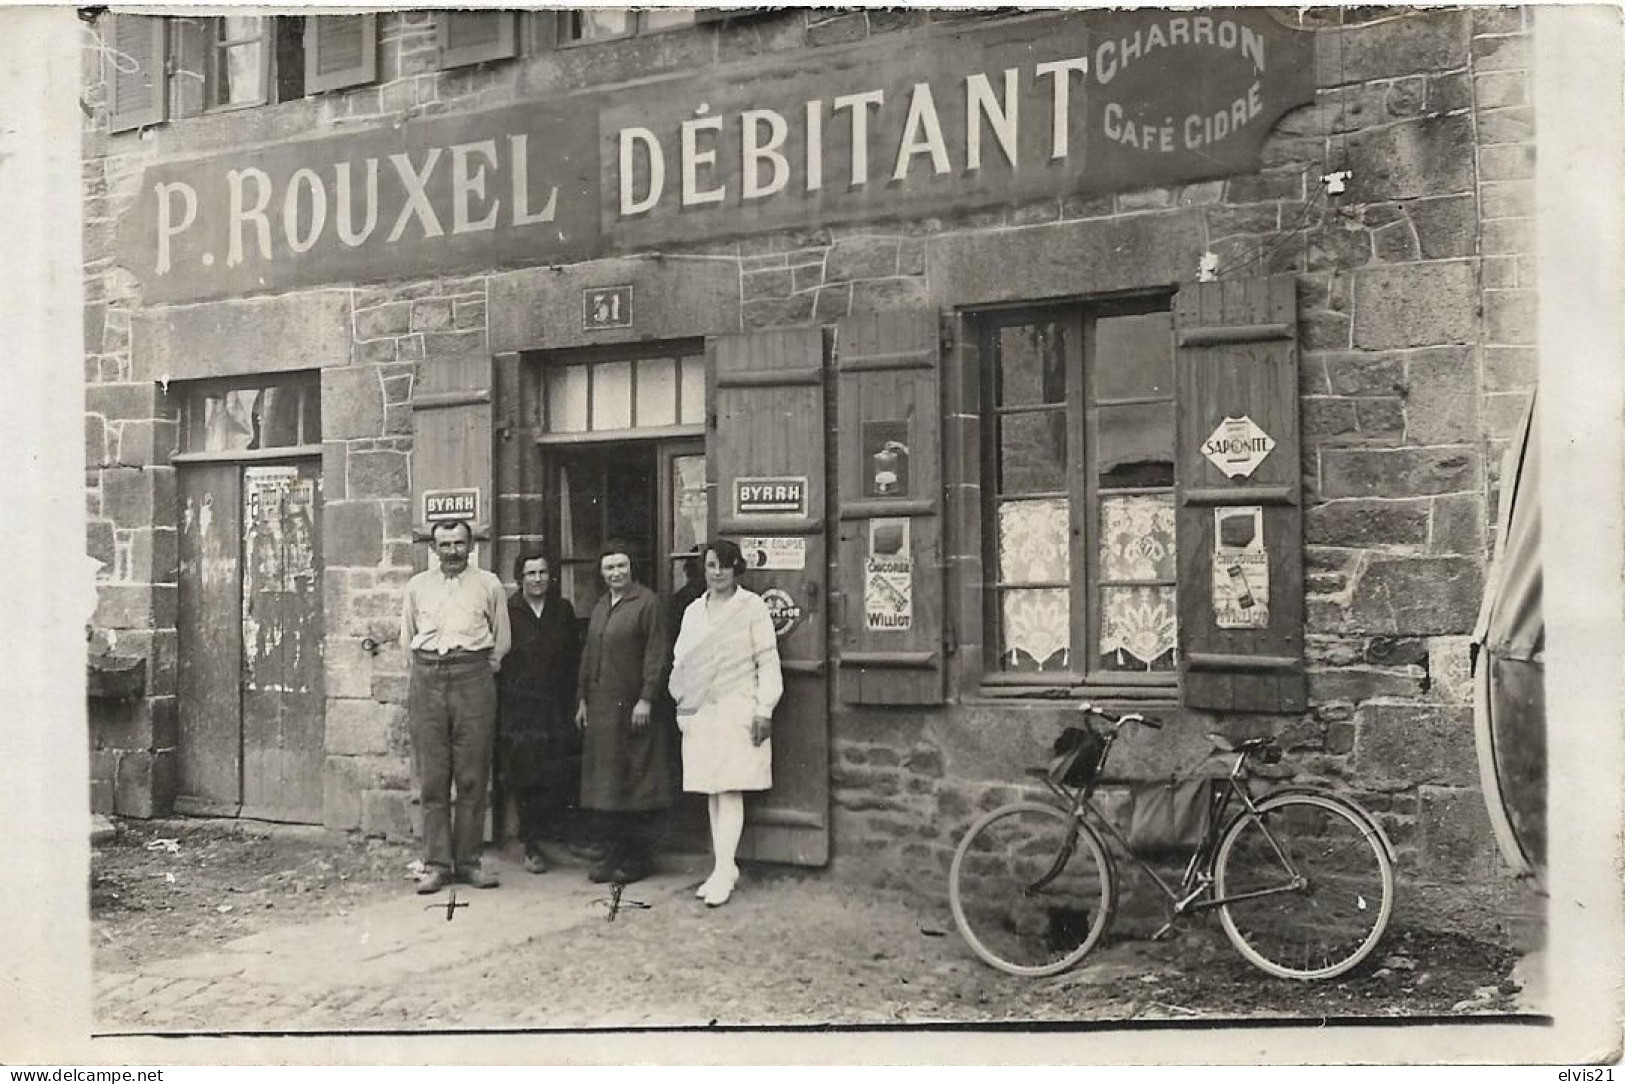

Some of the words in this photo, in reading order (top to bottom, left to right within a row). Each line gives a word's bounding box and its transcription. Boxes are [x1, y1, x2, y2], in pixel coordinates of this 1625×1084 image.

[1096, 16, 1265, 84] CHARRON
[618, 56, 1089, 217] DÉBITANT
[1104, 102, 1176, 152] CAFÉ
[1206, 437, 1271, 456] SAPONITE
[427, 496, 474, 512] BYRRH
[740, 485, 801, 501] BYRRH
